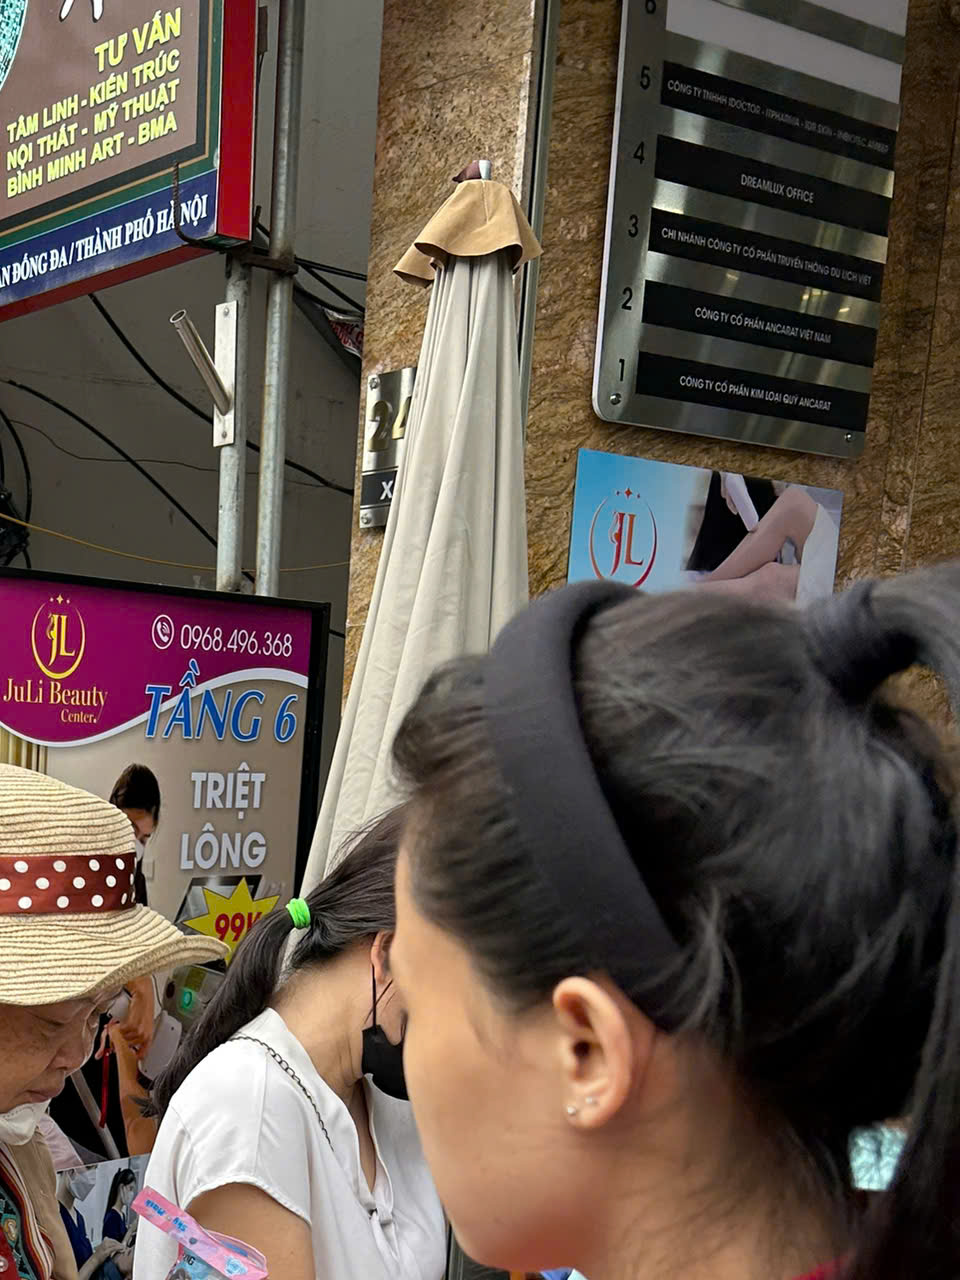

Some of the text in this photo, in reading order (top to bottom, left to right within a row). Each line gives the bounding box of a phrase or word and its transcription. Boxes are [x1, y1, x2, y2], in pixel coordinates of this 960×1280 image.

[94, 33, 128, 72] TƯ
[132, 7, 181, 55] VẤN
[6, 113, 39, 144] TÂM
[43, 94, 79, 129] LINH
[89, 72, 128, 108] KIẾN
[132, 49, 180, 87] TRÚC
[640, 66, 651, 90] 5
[667, 79, 692, 96] CÔNG
[692, 86, 703, 98] TY
[6, 145, 33, 172] NỘI
[37, 123, 78, 157] THẤT
[94, 104, 118, 135] MỸ
[122, 79, 180, 122] THUẬT
[6, 168, 42, 198] BÌNH
[47, 148, 86, 182] MINH
[90, 132, 124, 165] ART
[138, 111, 177, 146] BMA
[633, 141, 814, 203] 4 DREAMLUX OFFICE
[12, 252, 47, 284] ĐỐNG
[50, 247, 68, 271] ĐA
[75, 227, 123, 262] THÀNH
[124, 208, 154, 245] PHỐ
[180, 194, 208, 227] NỘI
[627, 214, 638, 238] 3
[661, 227, 677, 240] CHI
[678, 229, 706, 247] NHÁNH
[707, 236, 731, 254] CÔNG
[731, 242, 741, 255] TY
[742, 242, 755, 258] CỔ
[804, 258, 830, 275] THÔNG
[831, 266, 841, 279] DU
[621, 286, 632, 310] 2
[695, 306, 720, 323] CÔNG
[720, 311, 730, 324] TY
[730, 309, 743, 326] CỔ
[765, 319, 799, 337] ANCARAT
[799, 325, 814, 342] VIỆT
[815, 330, 831, 344] NAM
[619, 358, 625, 381] 1
[679, 375, 704, 391] CÔNG
[704, 378, 715, 391] TY
[715, 377, 728, 393] CỔ
[750, 385, 764, 399] KIM
[799, 393, 832, 411] ANCARAT
[180, 624, 293, 657] 0968.496.368
[3, 678, 108, 712] JuLi Beauty
[145, 658, 299, 743] TẦNG 6
[191, 761, 266, 820] TRIỆT
[180, 822, 267, 870] LÔNG
